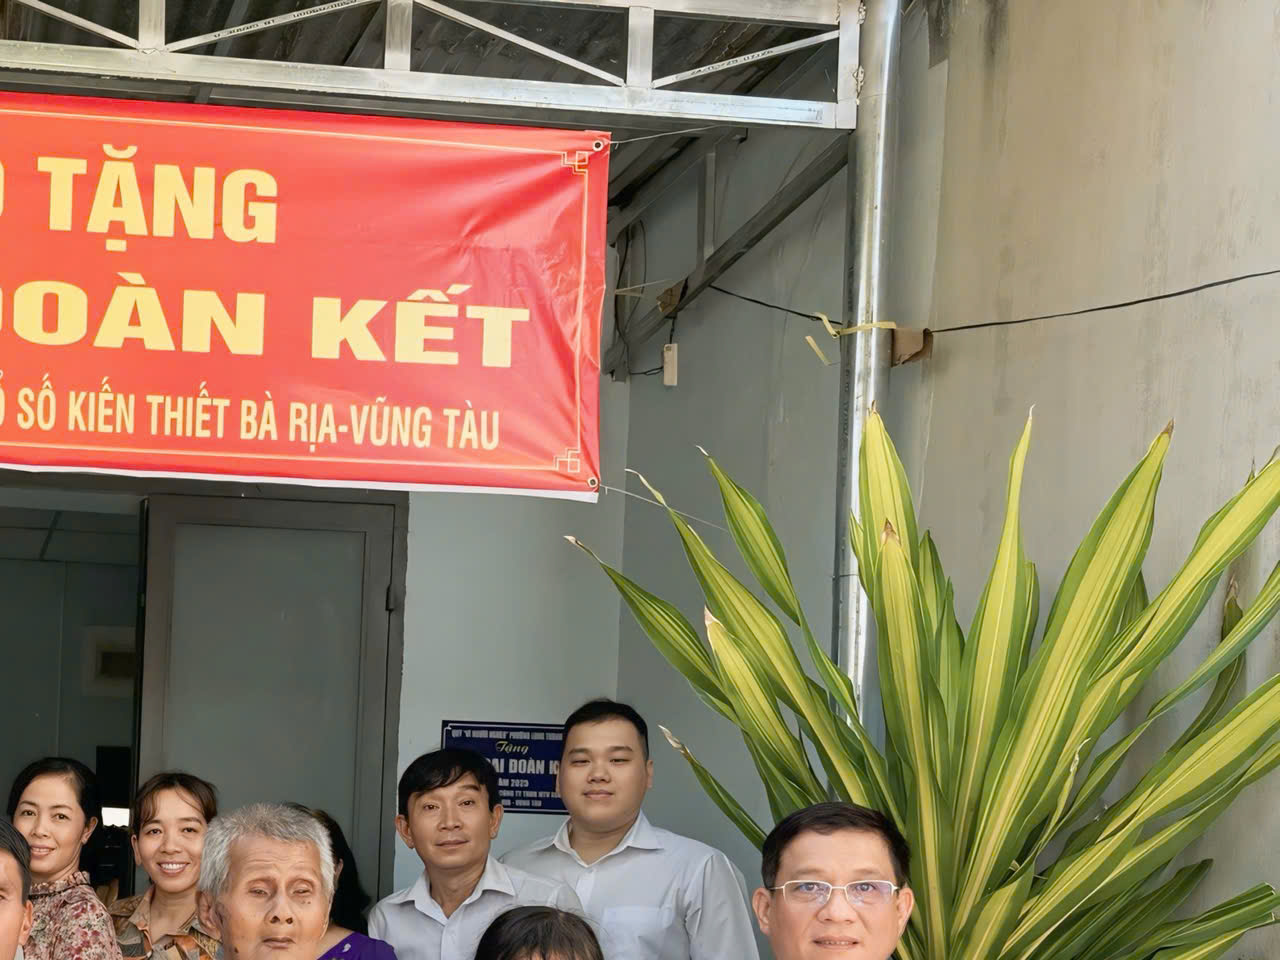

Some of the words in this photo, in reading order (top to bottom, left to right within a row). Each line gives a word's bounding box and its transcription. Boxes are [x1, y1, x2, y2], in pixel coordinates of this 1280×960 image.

[37, 143, 278, 252] TẶNG
[311, 283, 530, 369] KẾT
[16, 374, 57, 431] SỐ
[68, 377, 136, 434] KIẾN
[145, 381, 231, 438] THIẾT
[239, 390, 278, 441] BÀ
[288, 396, 433, 453] RỊA-VŨNG
[442, 399, 500, 451] TÀU
